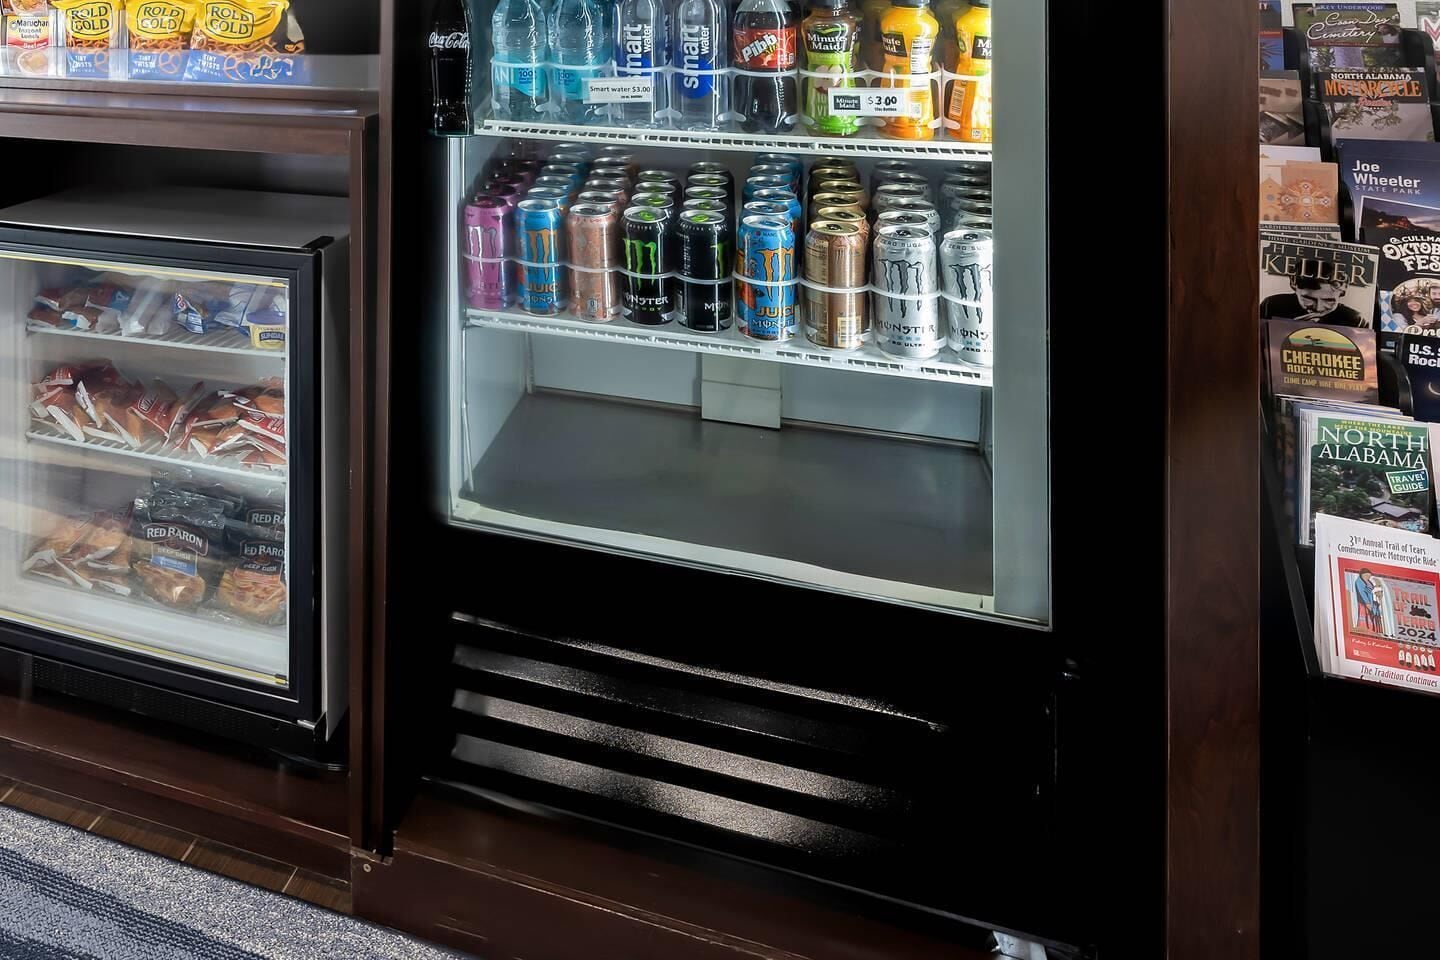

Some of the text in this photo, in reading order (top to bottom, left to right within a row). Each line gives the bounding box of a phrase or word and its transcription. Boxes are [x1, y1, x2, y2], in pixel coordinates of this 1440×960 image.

[72, 6, 108, 19] ROLD
[143, 6, 180, 18] ROLD
[210, 6, 249, 21] ROLD
[1326, 9, 1391, 29] Coon Dog
[76, 18, 109, 31] GOLD
[141, 18, 177, 30] GOLD
[210, 20, 248, 35] GOLD
[428, 32, 470, 49] Coca-Cola
[643, 24, 651, 52] water
[701, 26, 709, 55] water
[808, 33, 847, 42] Minute
[1307, 23, 1376, 43] Cemetery
[742, 33, 778, 62] Pibb
[812, 40, 841, 50] Maid
[71, 60, 92, 68] TWISTS
[203, 54, 217, 62] TINY
[681, 24, 699, 89] smart
[198, 59, 220, 70] TWISTS
[1366, 73, 1412, 81] ALABAMA
[1324, 79, 1422, 97] MOTORCYCLE
[868, 96, 897, 105] $ 3.00
[1352, 160, 1380, 172] Joe
[1353, 173, 1421, 188] Wheeler
[1273, 243, 1365, 264] HELEN
[1292, 239, 1328, 247] GARDENS
[1337, 244, 1371, 253] MUSEUM
[1264, 254, 1370, 288] KELLER
[1410, 344, 1435, 355] U.S.
[1282, 350, 1362, 369] CHEROKEE
[1287, 364, 1359, 379] ROCK VILLAGE
[1320, 426, 1426, 452] NORTH
[1370, 427, 1412, 436] MOUNTAINS
[1318, 443, 1426, 470] ALABAMA
[1390, 472, 1424, 483] TRAVEL
[1393, 481, 1424, 491] GUIDE
[252, 513, 271, 523] RED
[147, 527, 202, 547] RED BARON
[1362, 537, 1426, 555] Annual Trail of Tears
[1337, 543, 1436, 567] Commemorative Motorcycle Ride
[1393, 588, 1432, 606] TRAIL
[1394, 601, 1407, 613] OF
[1397, 613, 1436, 631] TEARS
[1399, 626, 1437, 642] 2024
[1361, 665, 1372, 675] The
[1374, 667, 1404, 681] Tradition
[1406, 672, 1437, 688] Continues
